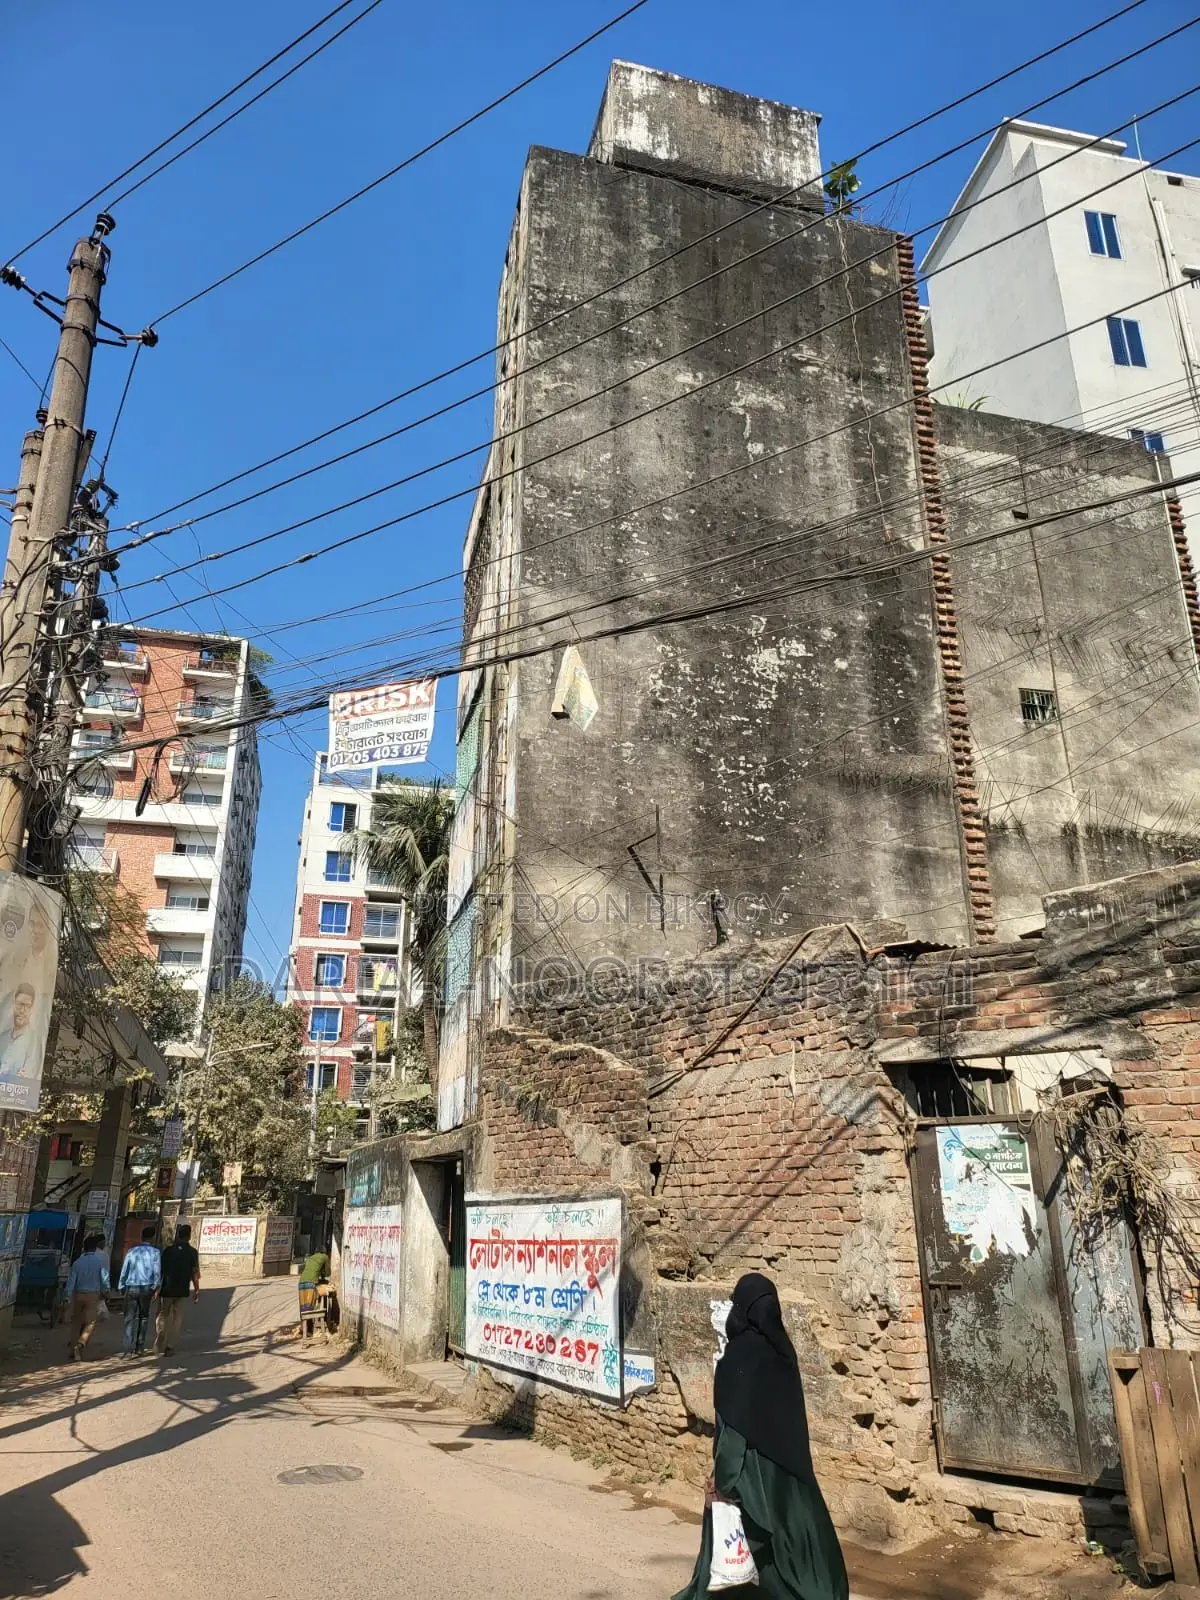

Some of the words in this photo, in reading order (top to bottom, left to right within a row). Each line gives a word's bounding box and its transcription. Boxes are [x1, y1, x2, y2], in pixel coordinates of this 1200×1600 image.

[334, 680, 430, 717] BRISK
[387, 728, 428, 743] সংযোগ
[373, 745, 399, 760] 403
[403, 741, 428, 755] 875
[517, 1231, 580, 1277] ন্যাশনাল
[580, 1236, 619, 1299] স্কুল
[493, 1281, 520, 1302] থেকে
[522, 1284, 547, 1309] ৮ম
